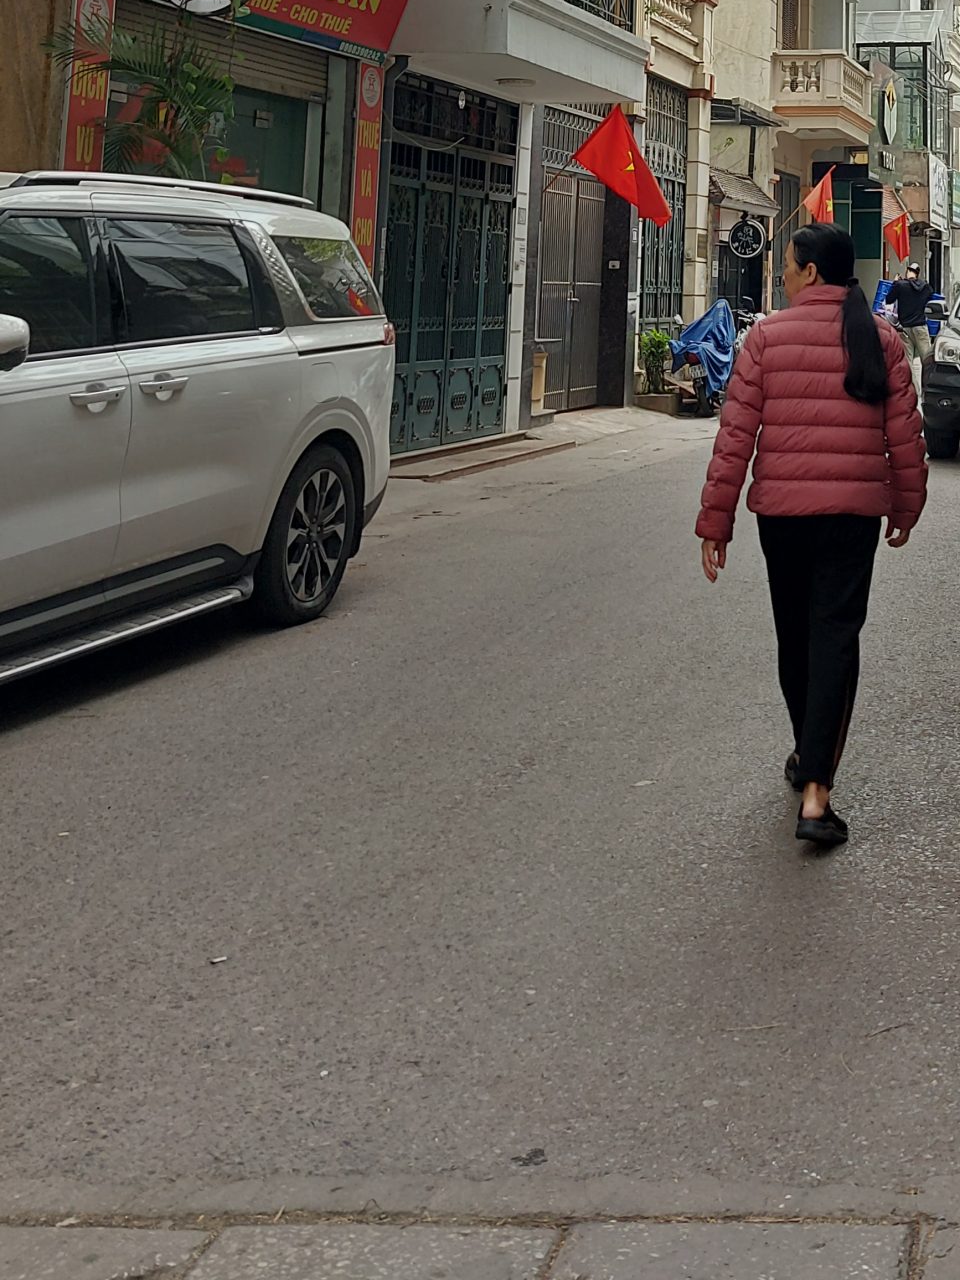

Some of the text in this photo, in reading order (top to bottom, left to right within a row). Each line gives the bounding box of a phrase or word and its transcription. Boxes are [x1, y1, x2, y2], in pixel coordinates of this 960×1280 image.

[289, 4, 319, 25] CHO
[319, 12, 352, 35] THUÊ
[72, 60, 107, 106] DỊCH
[359, 117, 380, 150] THUÊ
[354, 217, 373, 247] CHO
